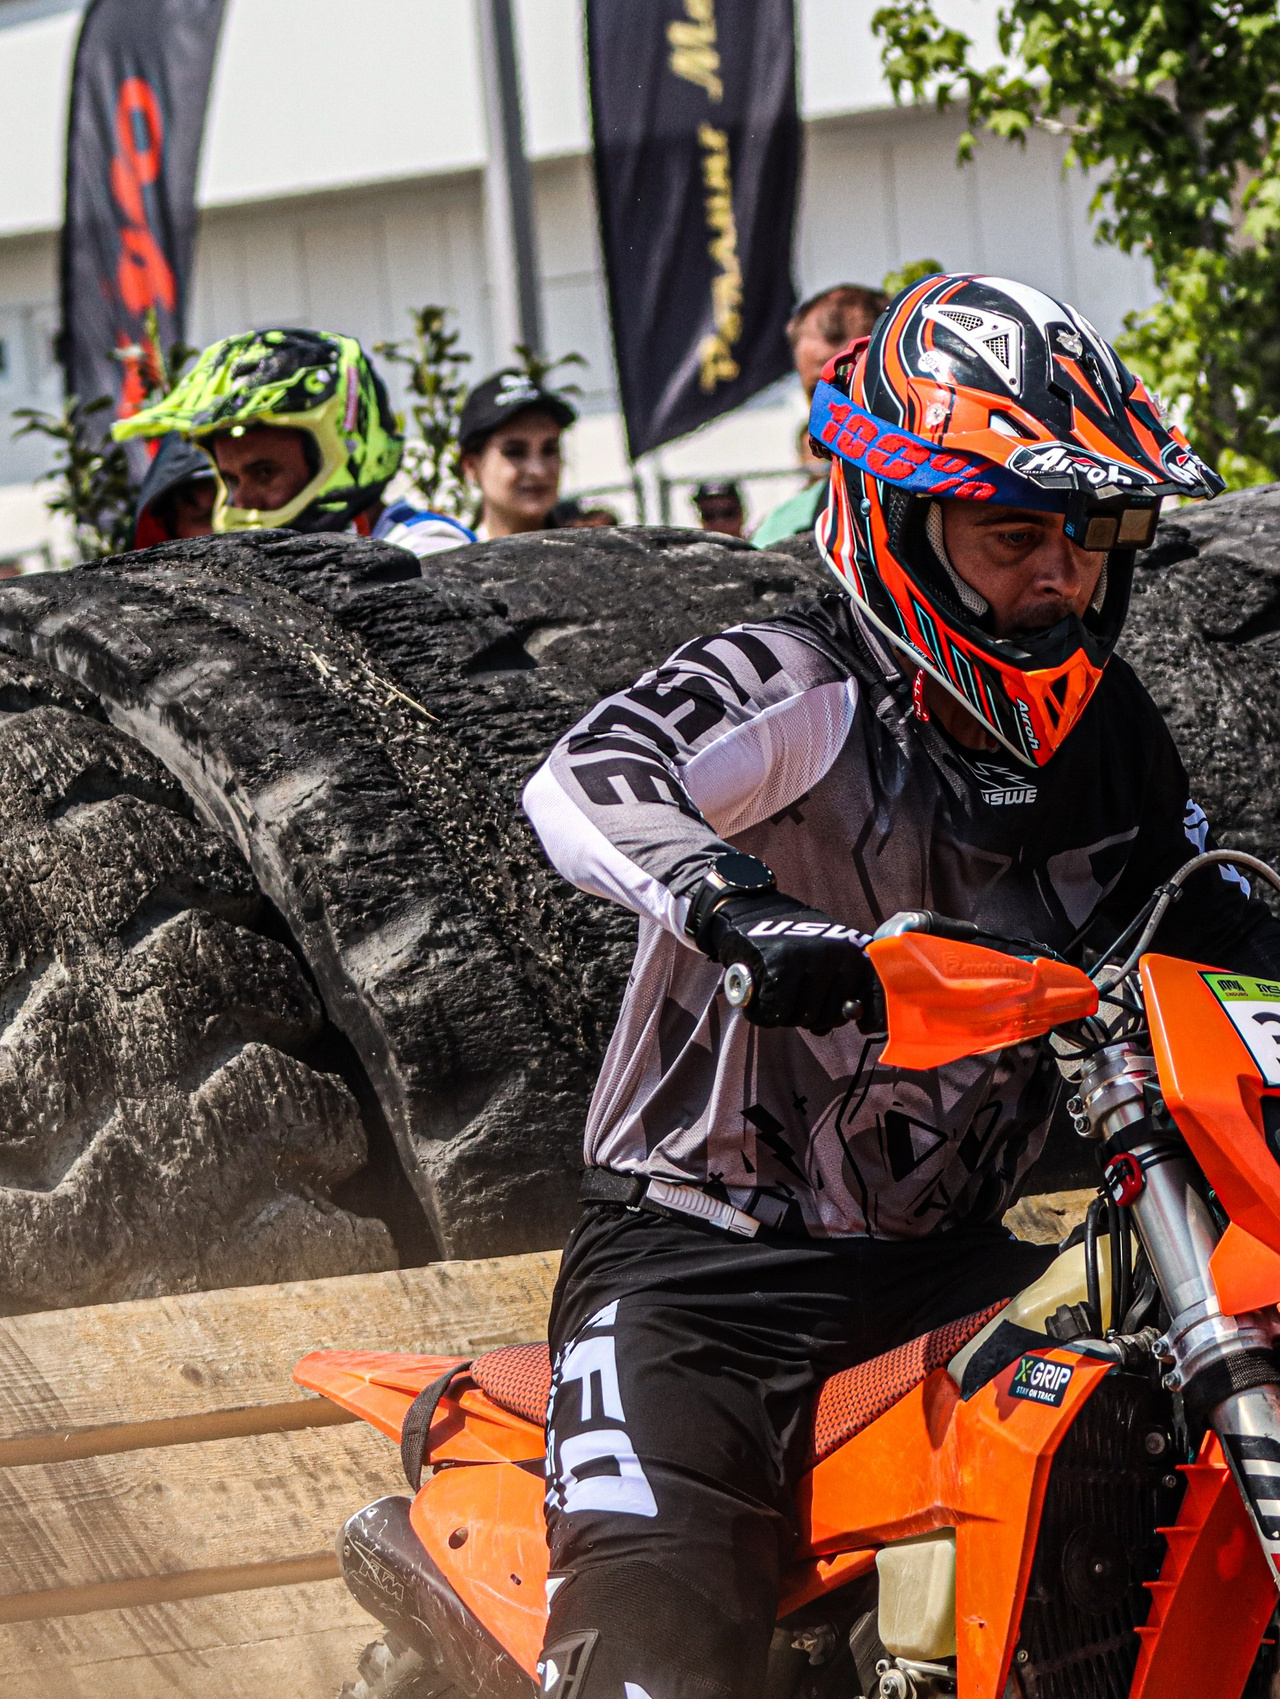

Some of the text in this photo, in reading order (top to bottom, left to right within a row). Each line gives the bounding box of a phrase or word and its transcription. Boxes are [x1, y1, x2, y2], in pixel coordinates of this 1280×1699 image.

[821, 402, 998, 500] 100%
[1019, 448, 1132, 485] Airoh
[1015, 697, 1041, 750] Airoh
[746, 920, 874, 949] USW
[1014, 1358, 1072, 1391] X-GRIP
[1015, 1386, 1056, 1403] STAY ON TRACK
